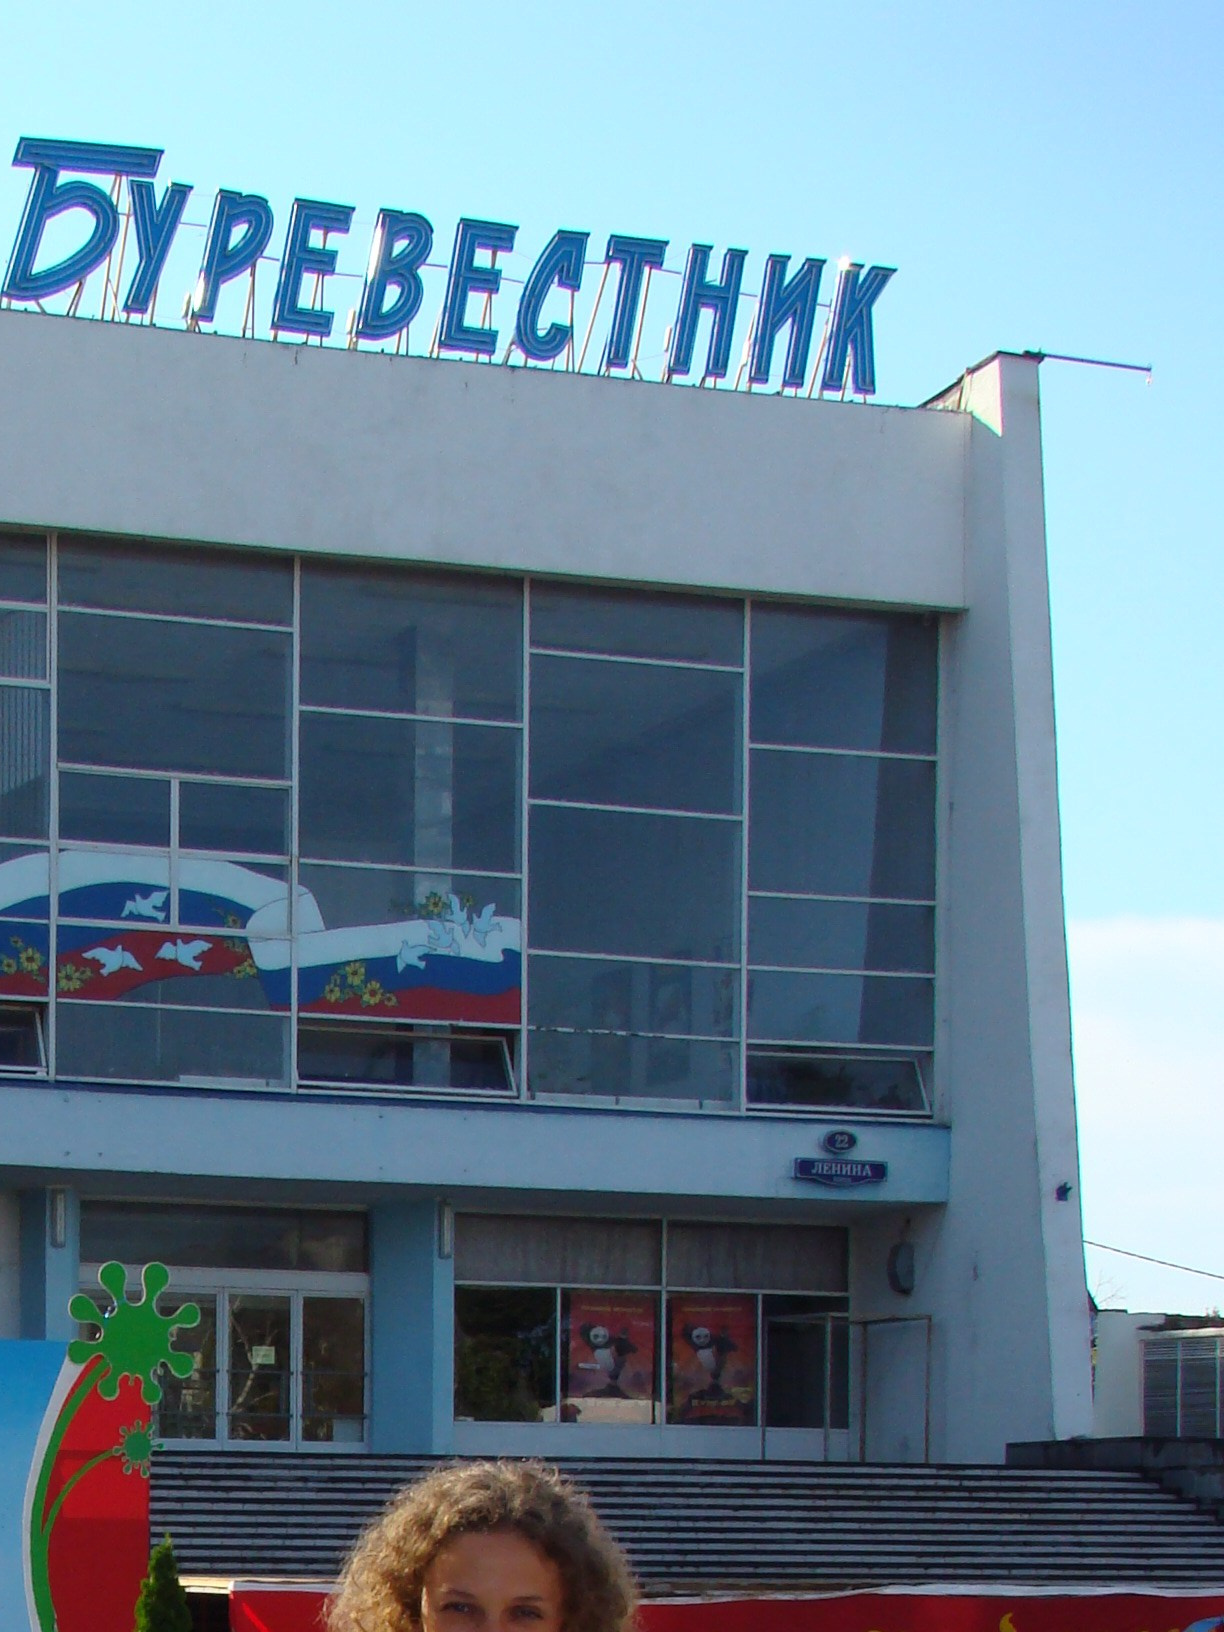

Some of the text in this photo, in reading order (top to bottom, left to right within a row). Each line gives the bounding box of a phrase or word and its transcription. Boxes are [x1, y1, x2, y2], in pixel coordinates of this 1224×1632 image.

[0, 135, 898, 395] БУРЕВЕСТНИК
[834, 1134, 849, 1149] 22
[812, 1162, 873, 1177] ЛЕНИНА
